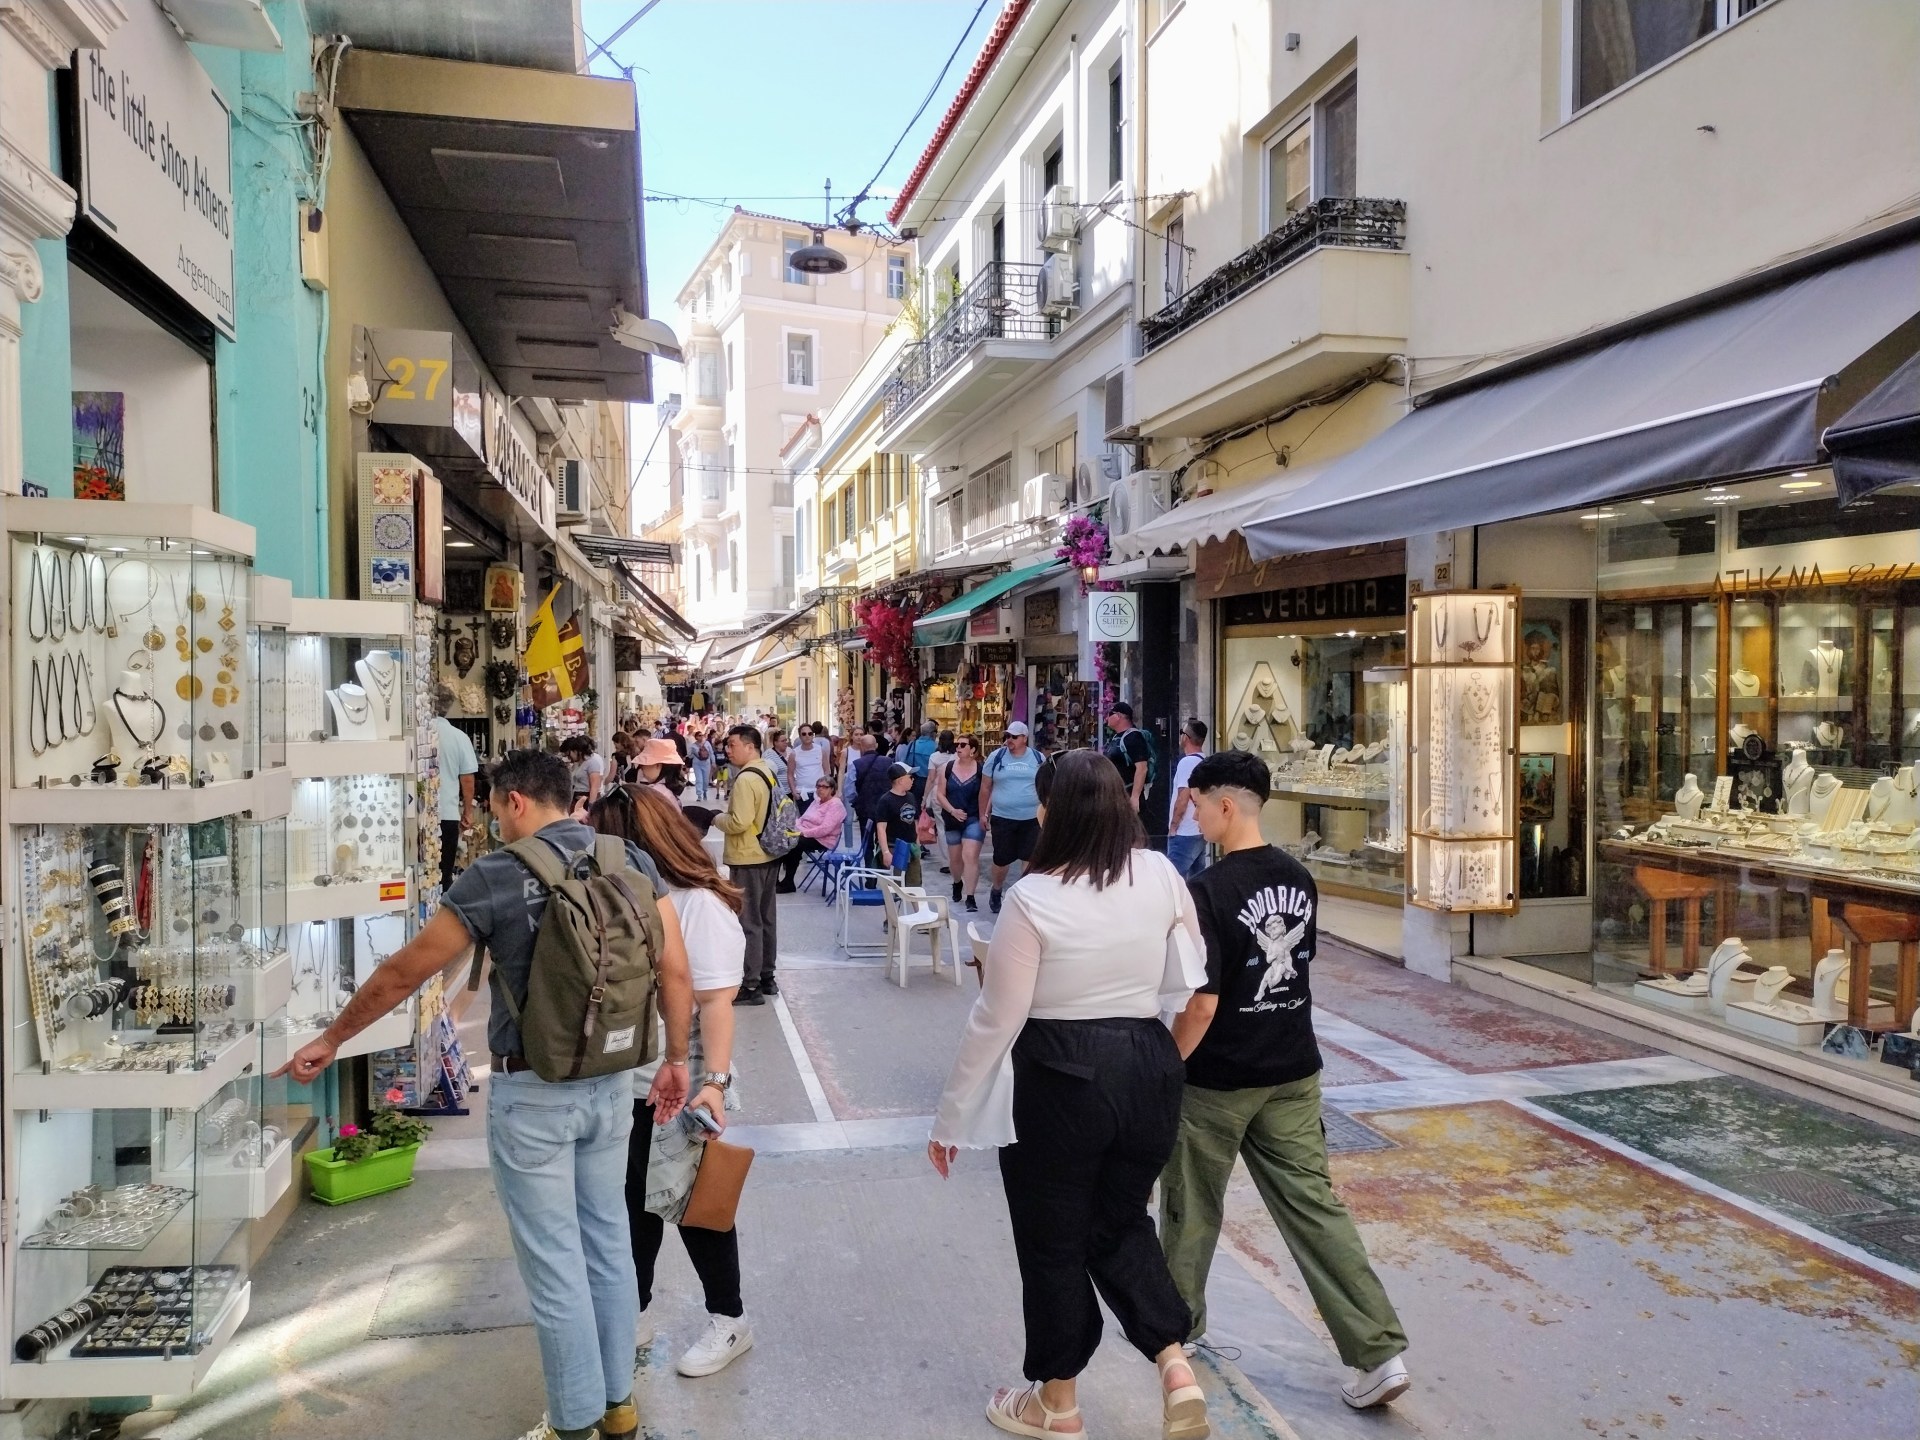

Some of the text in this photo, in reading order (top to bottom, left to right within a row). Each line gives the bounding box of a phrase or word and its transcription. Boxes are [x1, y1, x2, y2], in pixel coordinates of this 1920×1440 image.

[90, 49, 229, 240] the little shop Athens
[177, 243, 231, 315] Argentum
[386, 357, 448, 401] 27
[1437, 568, 1448, 579] 22
[1709, 562, 1915, 600] ATHENA Gold
[1262, 580, 1377, 619] VERGINA
[1411, 584, 1421, 593] 24
[1102, 603, 1128, 616] 24K
[1102, 617, 1129, 625] SUITES
[988, 653, 1008, 661] Shop
[893, 698, 904, 710] 10
[1237, 885, 1313, 935] HOODRICH
